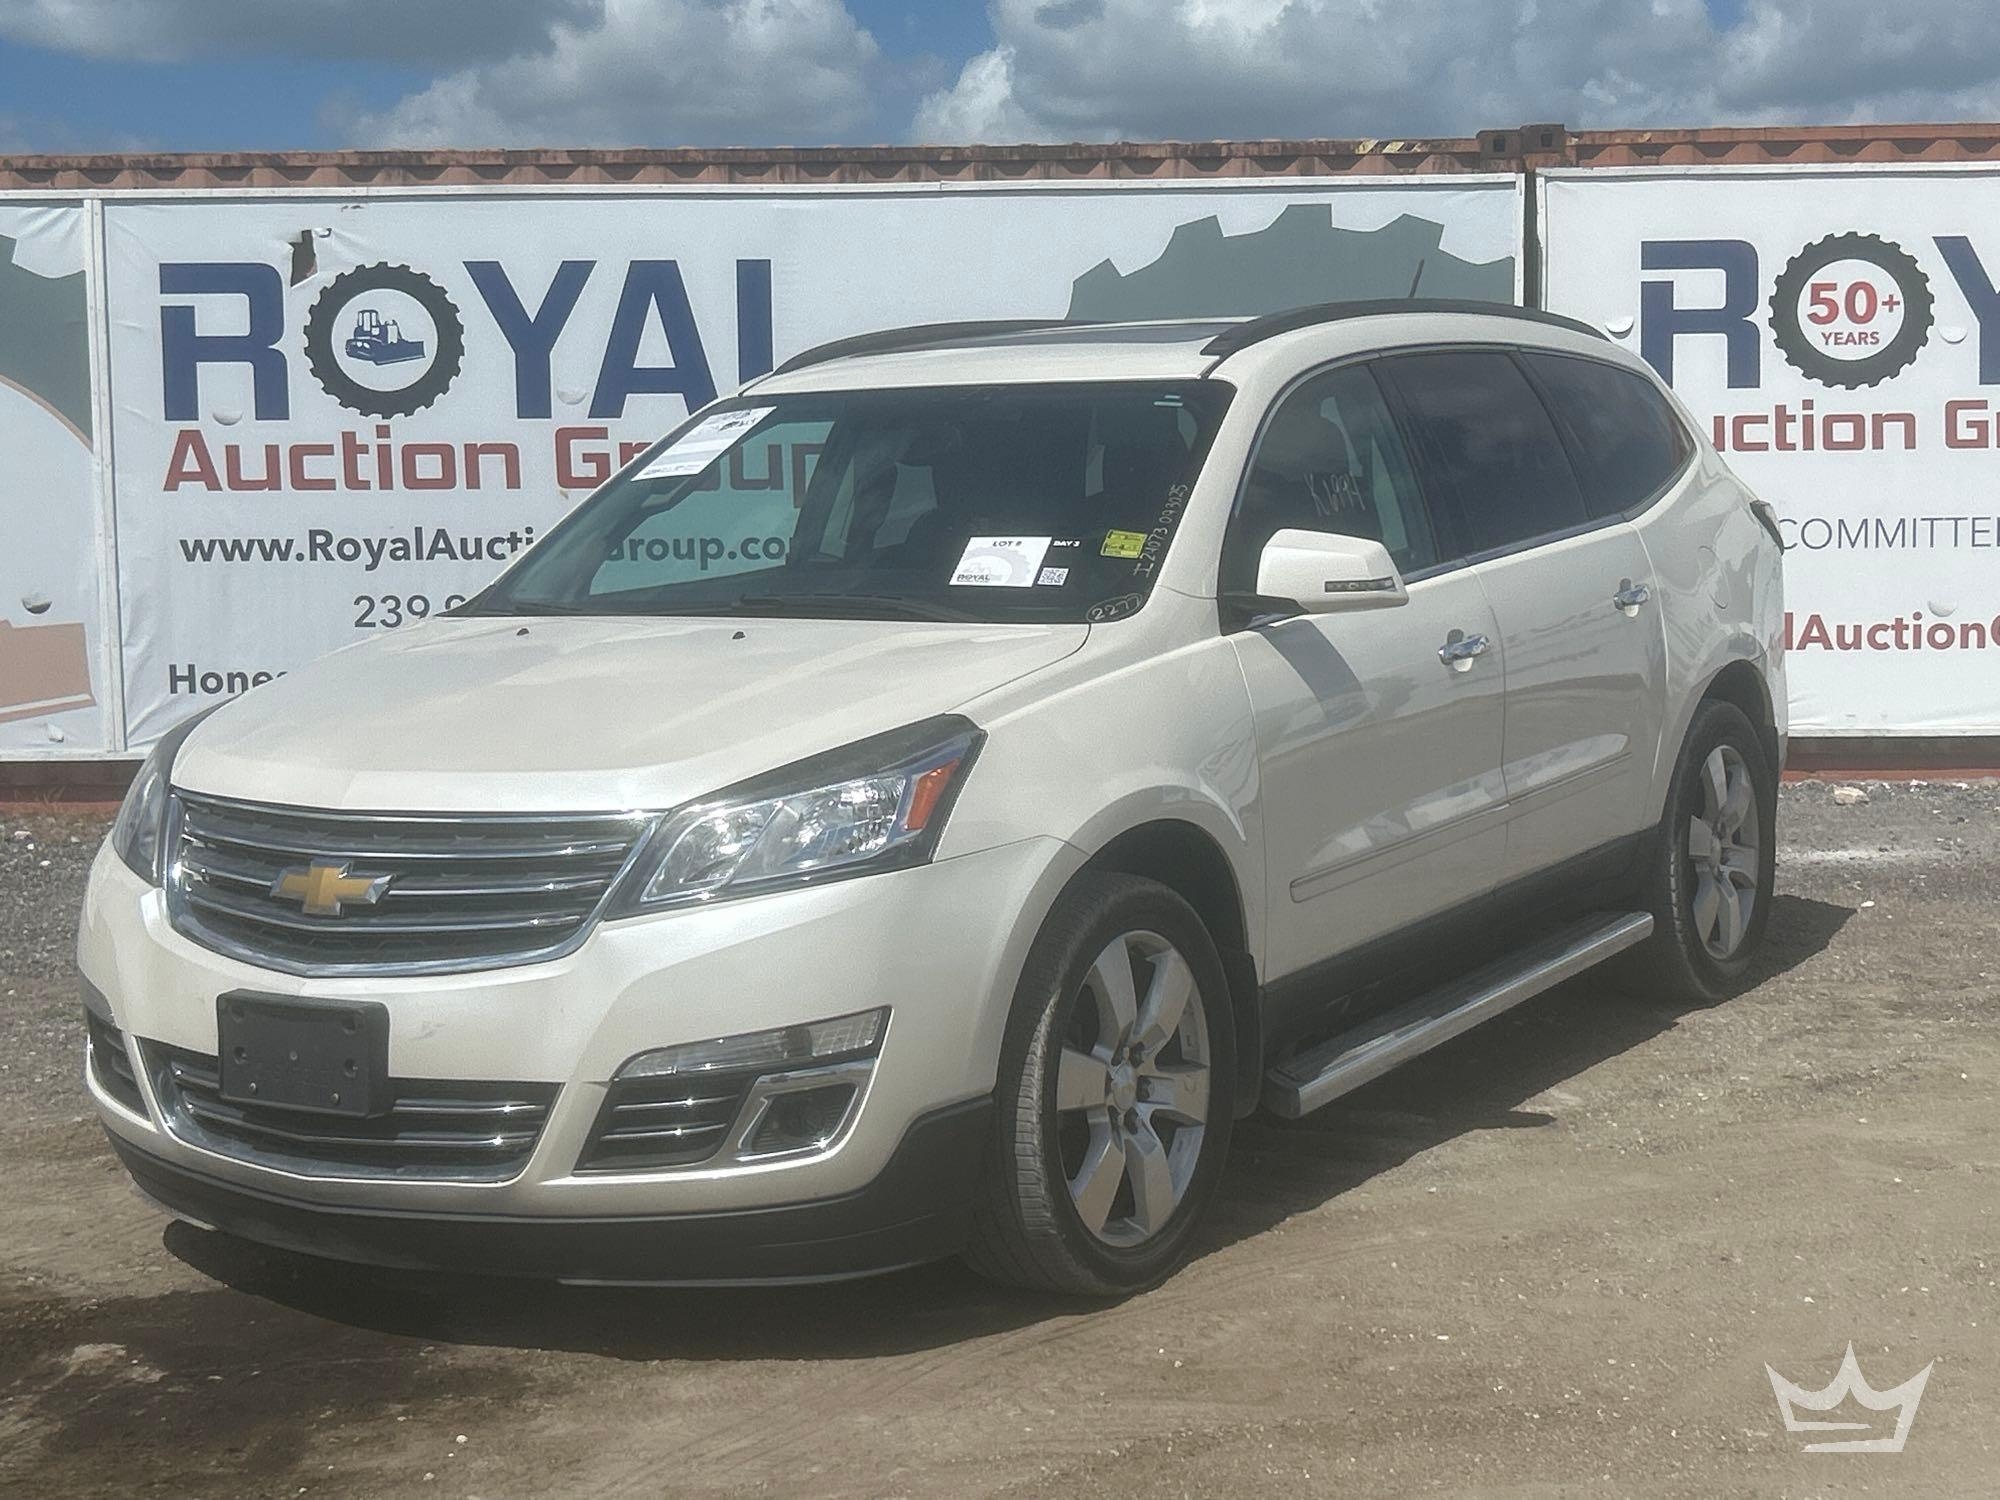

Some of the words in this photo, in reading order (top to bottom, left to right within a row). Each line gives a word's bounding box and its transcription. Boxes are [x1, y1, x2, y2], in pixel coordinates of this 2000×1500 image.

[1806, 281, 1900, 325] 50+
[1821, 331, 1880, 346] YEARS
[1945, 399, 2000, 449] G
[163, 424, 521, 492] Auction
[555, 427, 826, 508] Grup
[1778, 517, 2000, 549] COMMITTE
[956, 574, 991, 582] ROYAL
[168, 663, 288, 694] Hone
